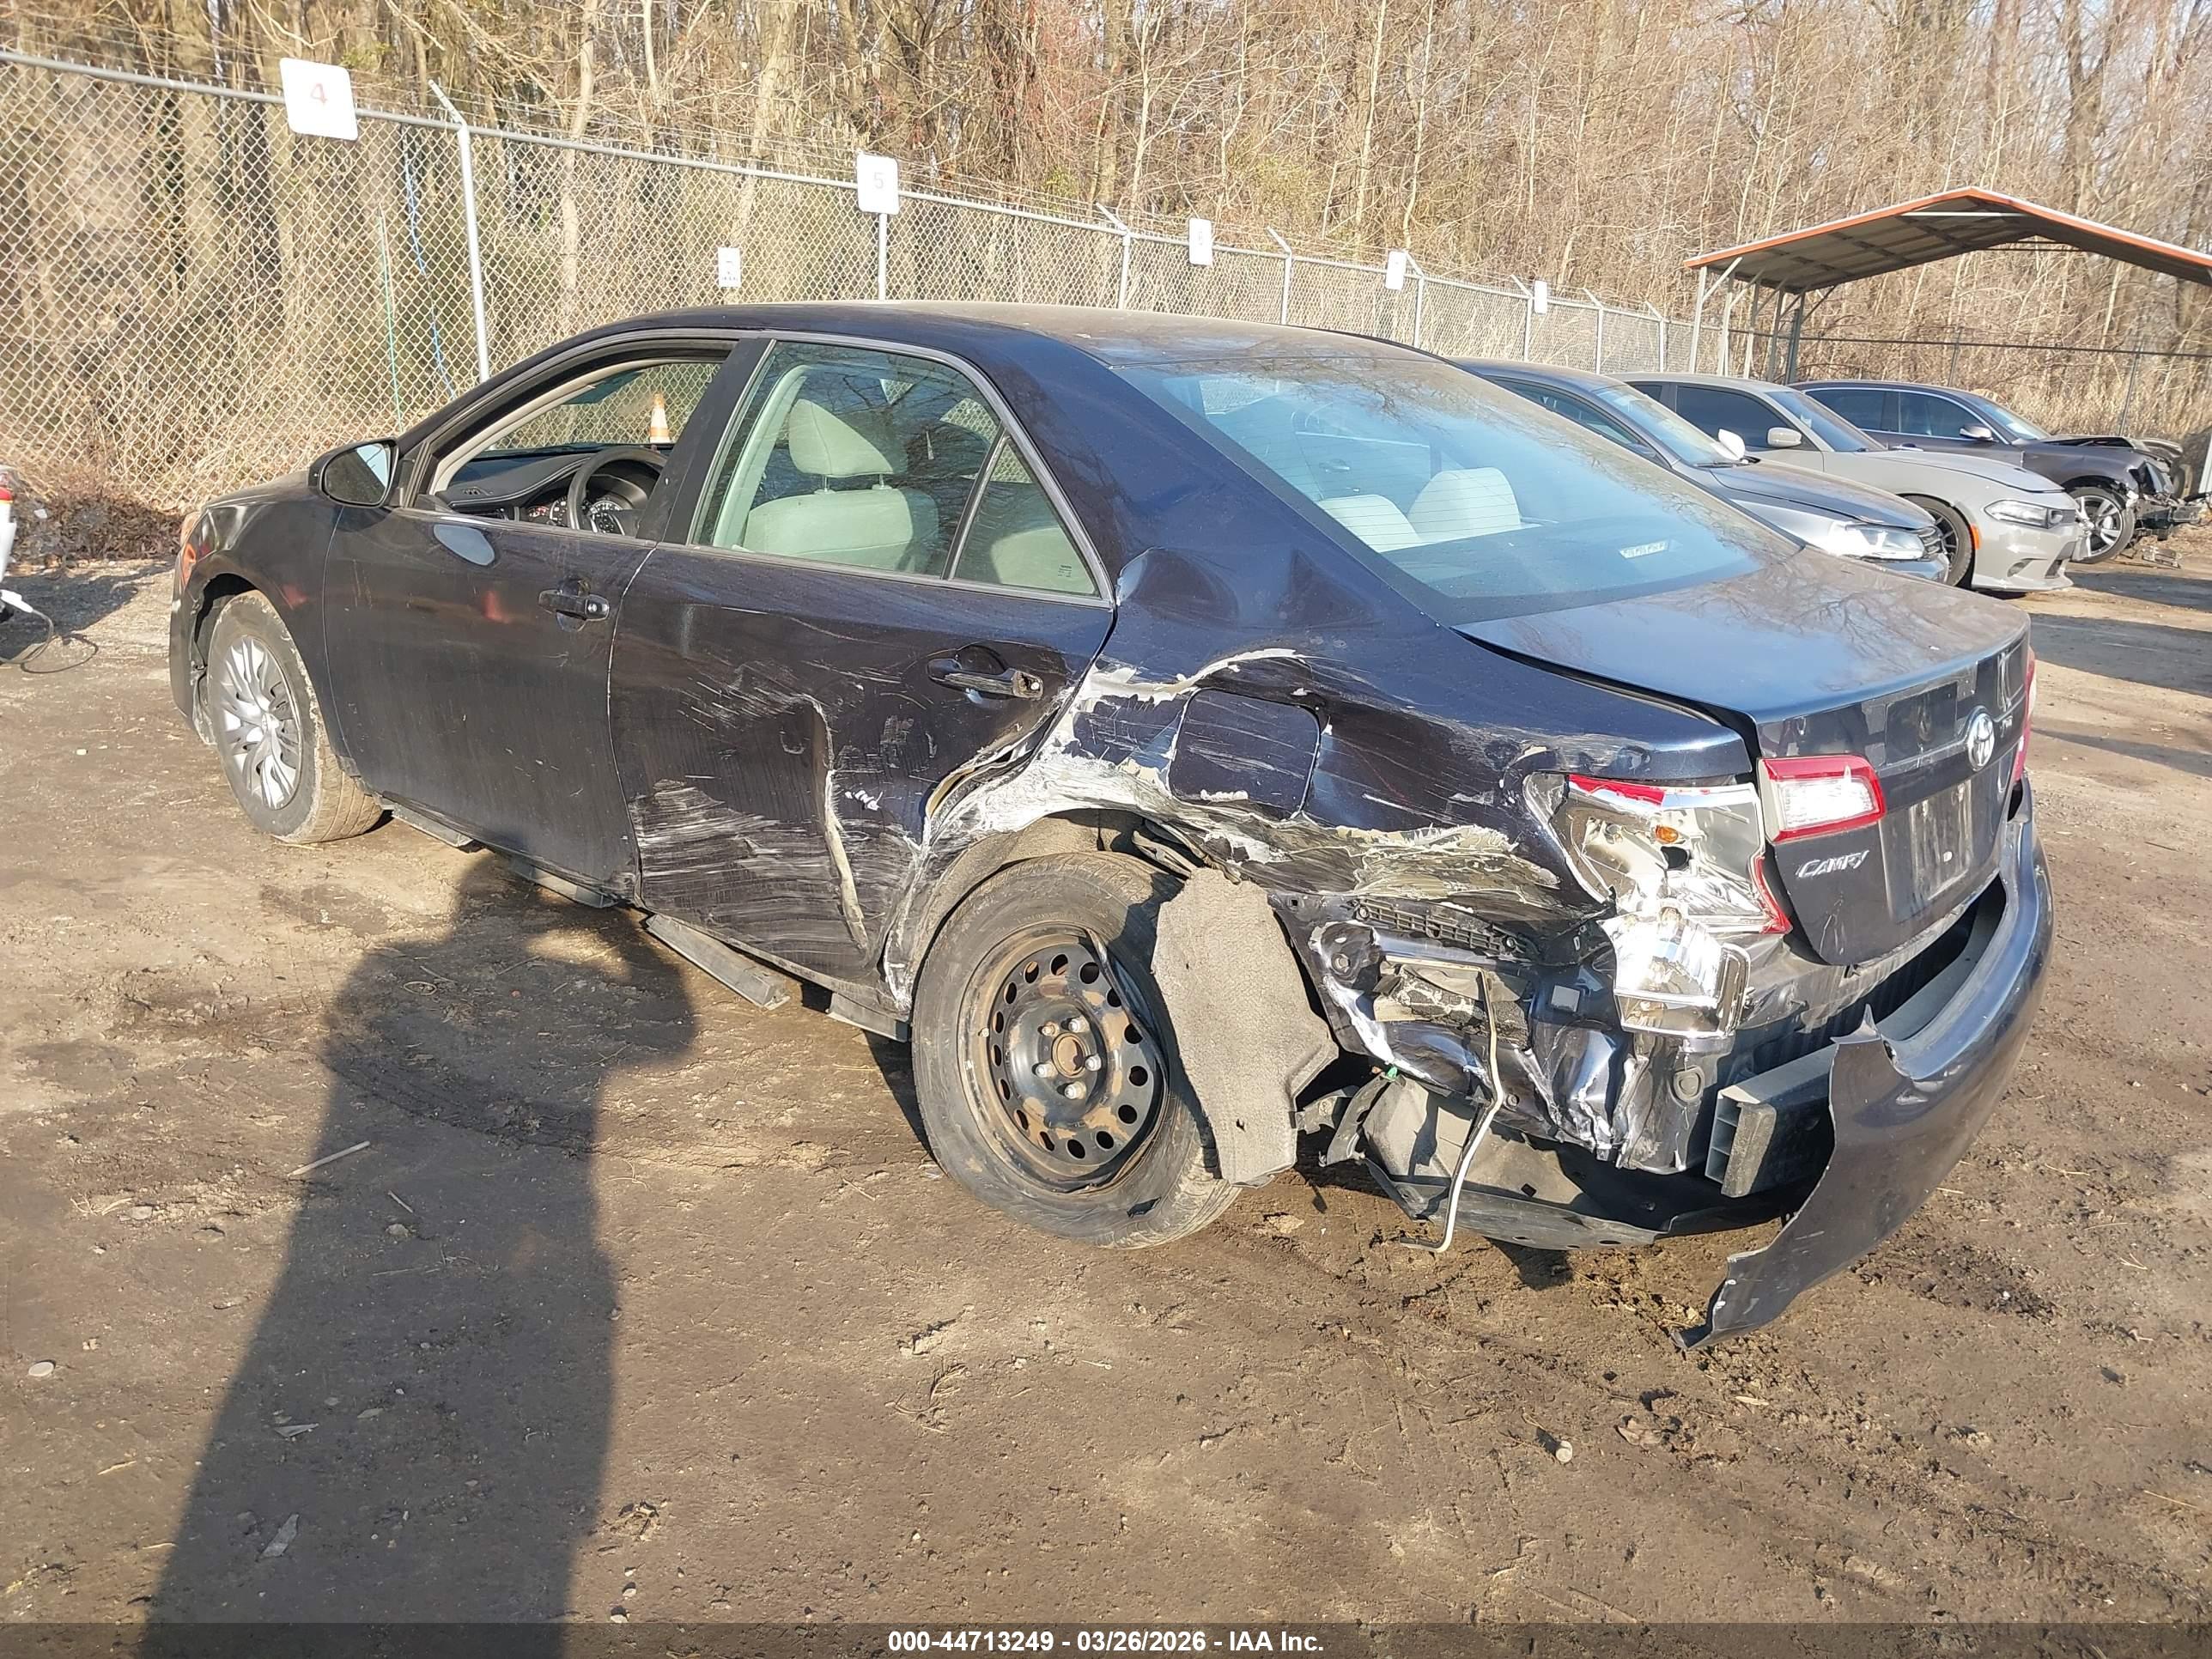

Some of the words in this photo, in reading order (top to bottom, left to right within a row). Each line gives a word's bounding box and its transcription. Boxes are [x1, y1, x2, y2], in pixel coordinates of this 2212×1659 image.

[310, 82, 328, 105] 4
[873, 172, 884, 190] 5
[1795, 849, 1870, 878] CAMRY
